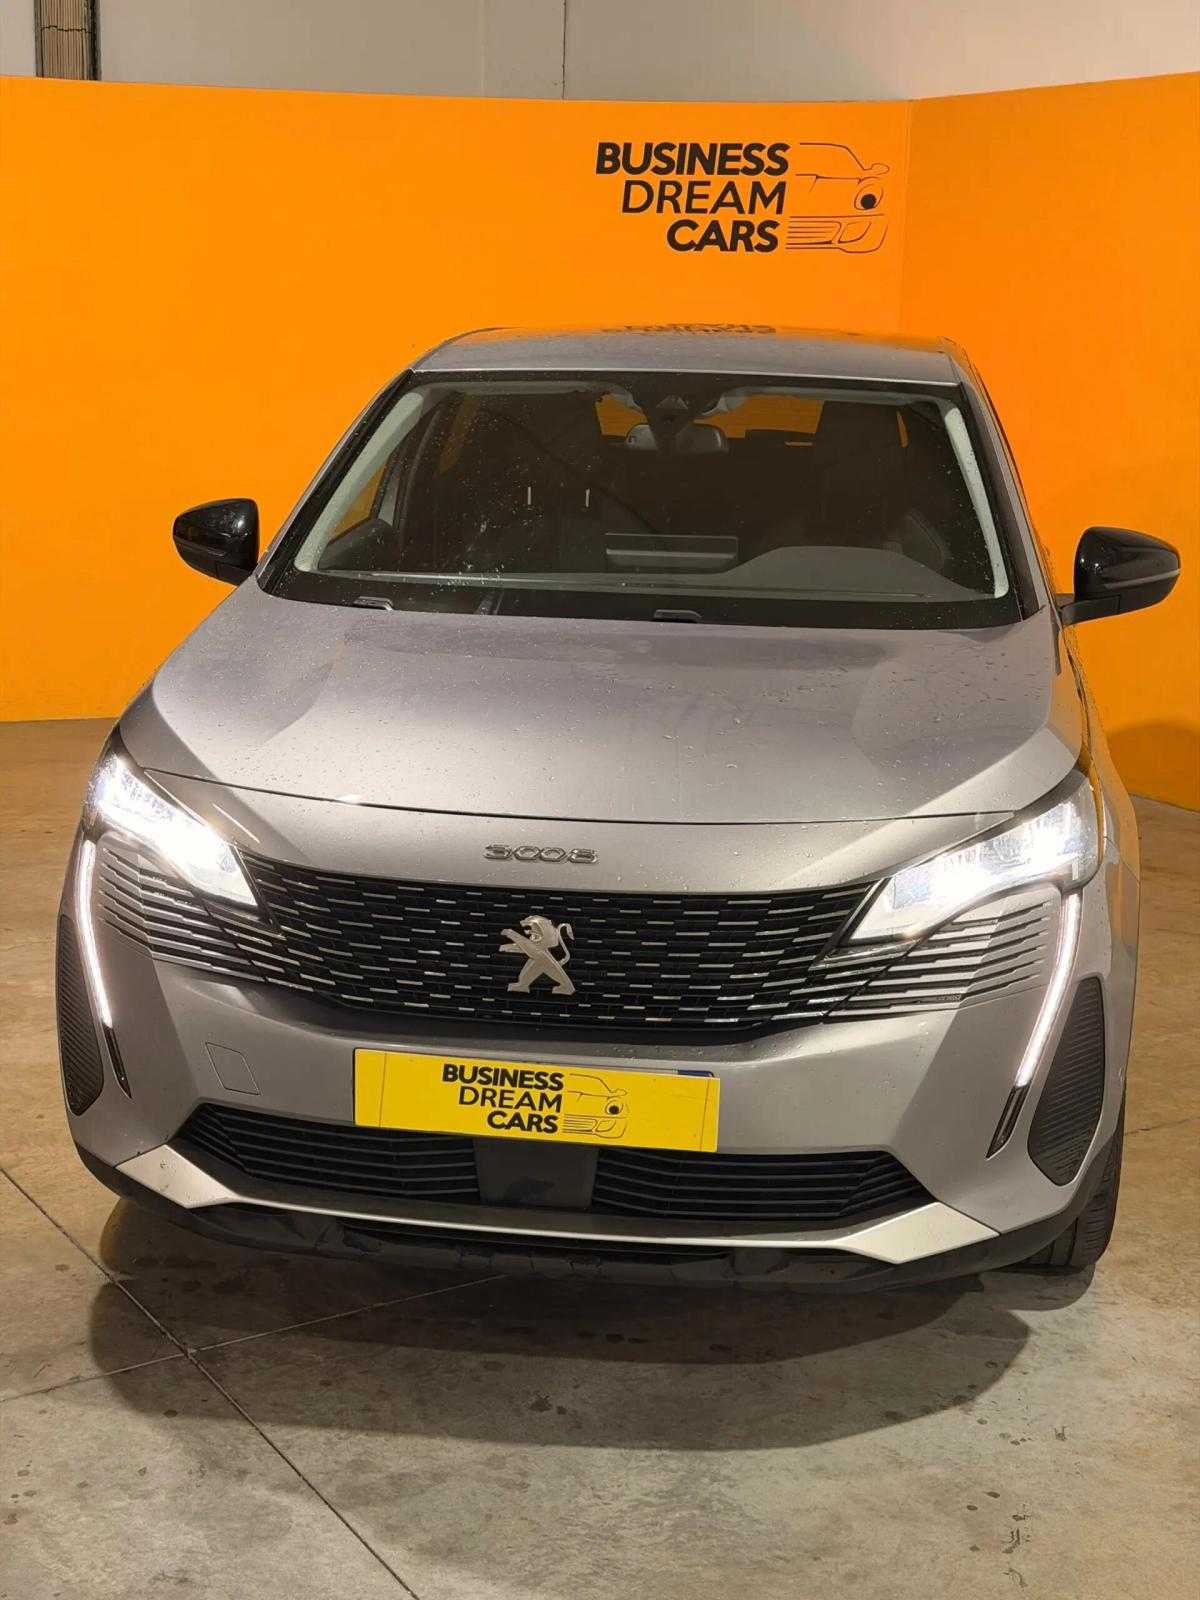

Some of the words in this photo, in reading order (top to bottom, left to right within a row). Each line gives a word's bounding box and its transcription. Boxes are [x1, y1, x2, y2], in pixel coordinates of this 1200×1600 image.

[596, 142, 790, 175] BUSINESS
[622, 180, 786, 214] DREAM
[667, 219, 780, 252] CARS
[484, 845, 598, 864] 3008
[443, 1064, 564, 1091] BUSINESS
[459, 1086, 562, 1113] DREAM
[487, 1111, 558, 1133] CARS
